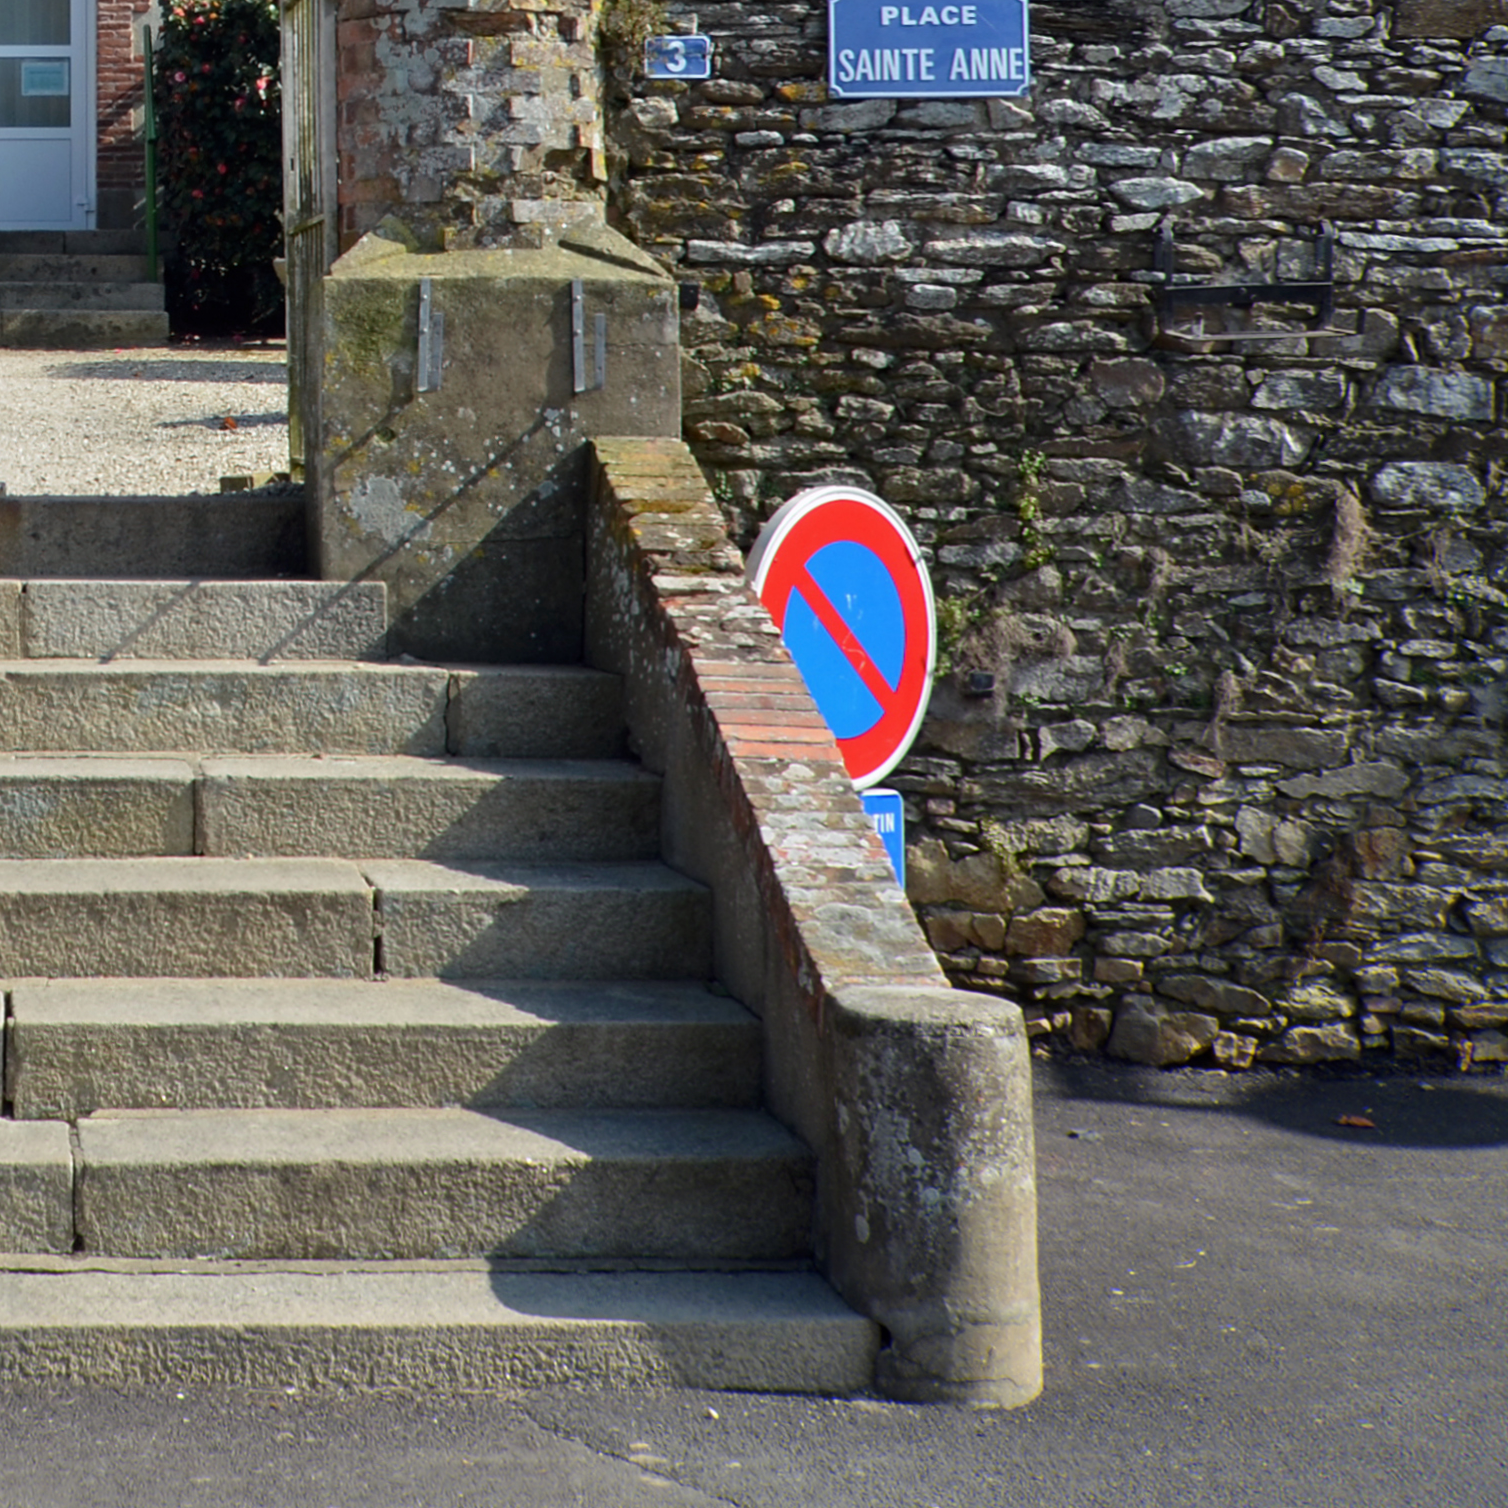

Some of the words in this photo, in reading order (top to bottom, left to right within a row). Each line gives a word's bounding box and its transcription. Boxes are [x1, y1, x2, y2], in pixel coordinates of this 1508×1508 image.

[880, 5, 978, 27] PLACE
[666, 41, 688, 74] 3
[838, 48, 936, 83] SAINTE
[950, 47, 1024, 81] ANNE
[872, 812, 896, 834] TIN
